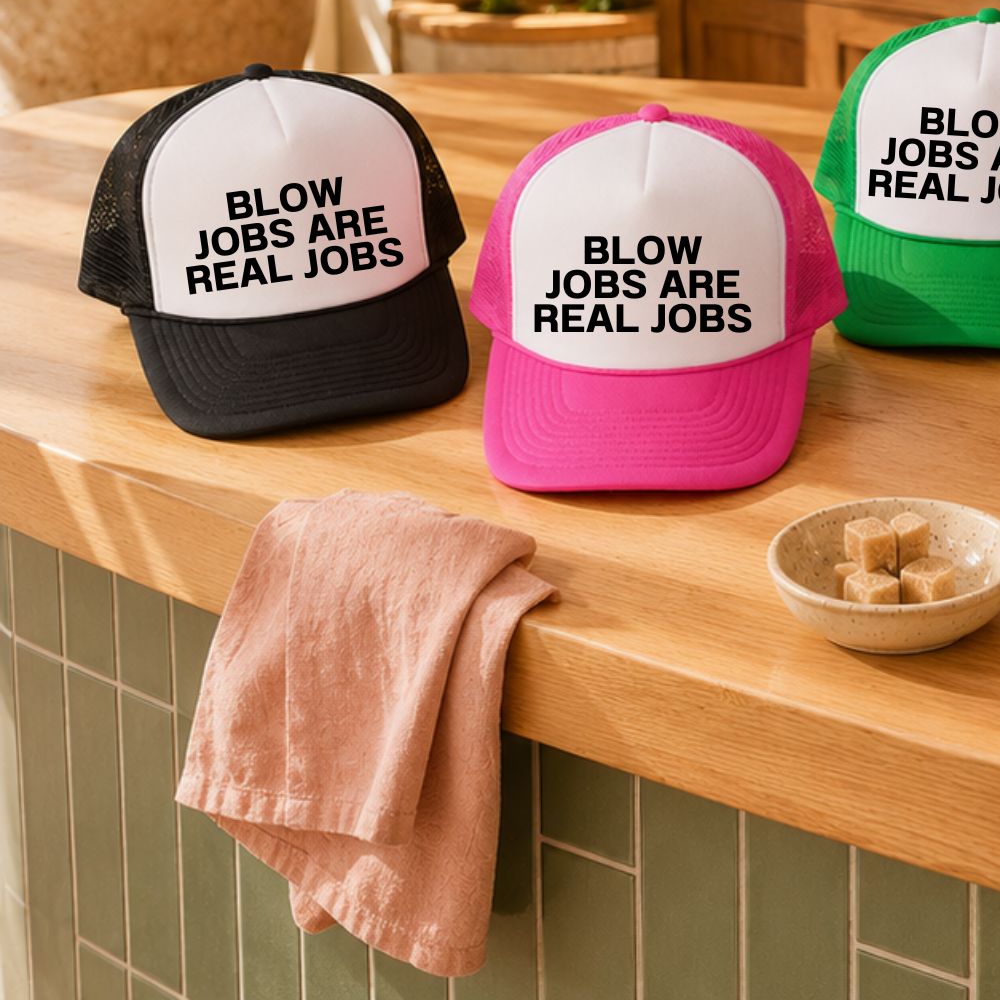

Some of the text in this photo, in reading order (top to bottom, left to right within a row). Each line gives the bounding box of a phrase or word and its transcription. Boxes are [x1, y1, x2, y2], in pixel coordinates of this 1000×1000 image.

[880, 137, 979, 171] JOBS
[225, 176, 343, 221] BLOW
[868, 168, 970, 203] REAL
[194, 204, 389, 260] JOBS ARE
[185, 237, 404, 295] REAL JOBS
[584, 235, 703, 266] BLOW
[545, 269, 740, 300] JOBS ARE
[534, 303, 752, 334] REAL JOBS
